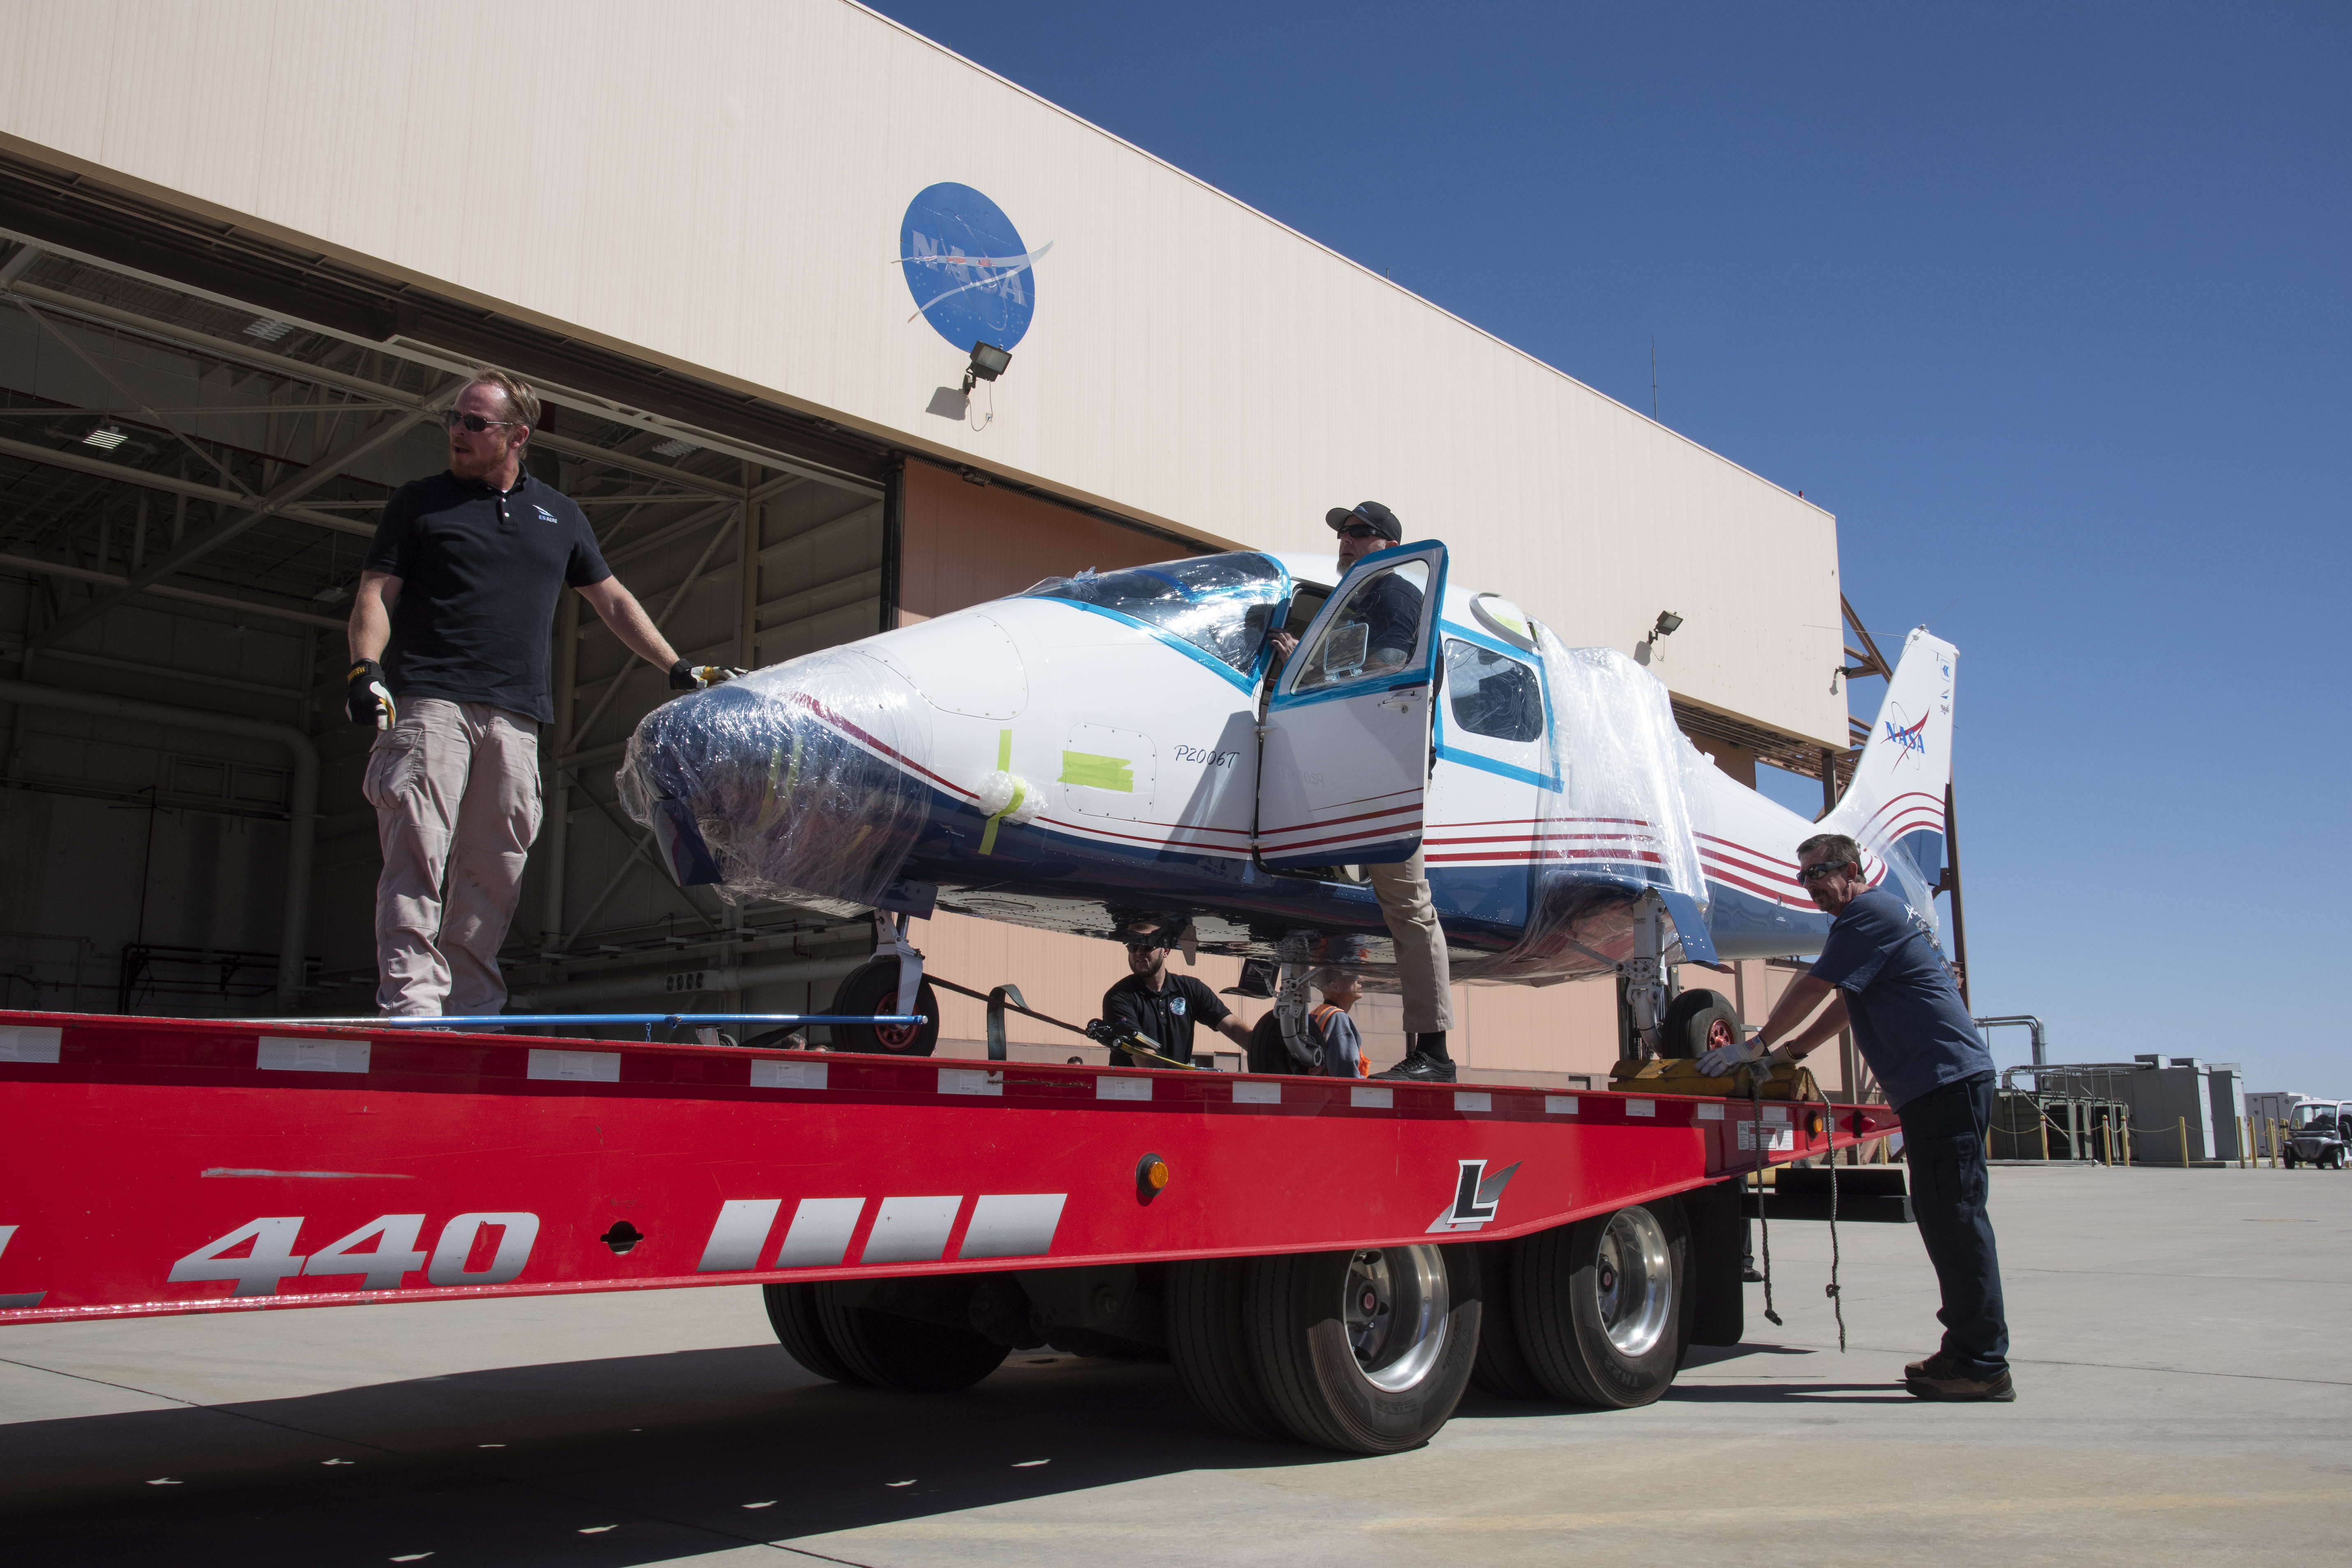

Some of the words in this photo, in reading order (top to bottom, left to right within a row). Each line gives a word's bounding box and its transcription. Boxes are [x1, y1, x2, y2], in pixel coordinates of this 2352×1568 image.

[911, 229, 1027, 307] NASA
[1884, 721, 1925, 754] NASA
[1174, 745, 1240, 768] P2006T
[166, 1212, 540, 1297] 440
[1604, 1355, 1639, 1387] TH22
